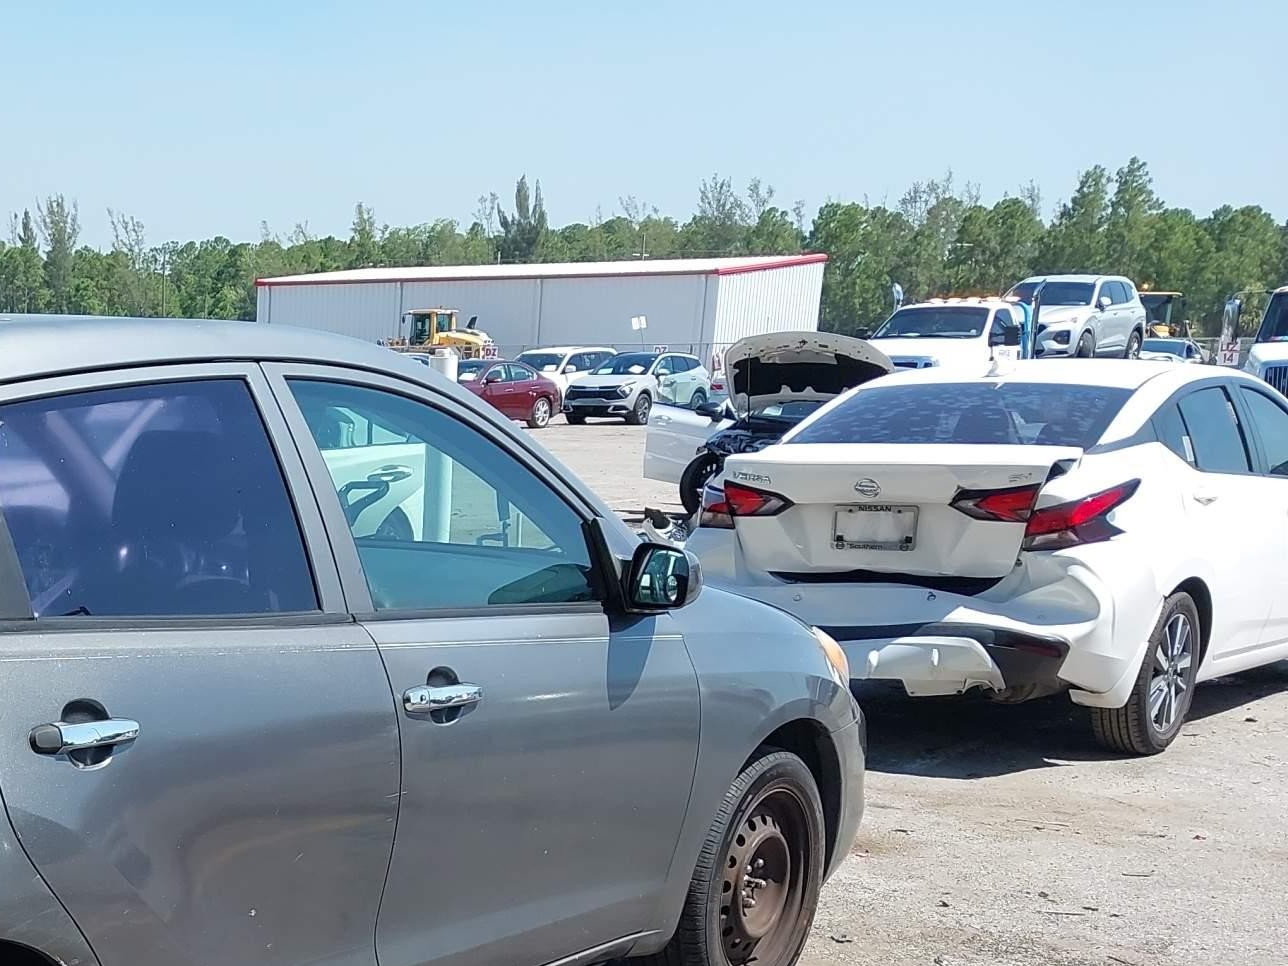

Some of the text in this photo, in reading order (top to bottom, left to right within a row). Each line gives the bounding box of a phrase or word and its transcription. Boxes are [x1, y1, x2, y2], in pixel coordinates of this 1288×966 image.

[486, 348, 497, 357] DZ
[1223, 353, 1234, 363] 14
[732, 471, 772, 485] VERSA
[858, 505, 892, 513] NISSAN
